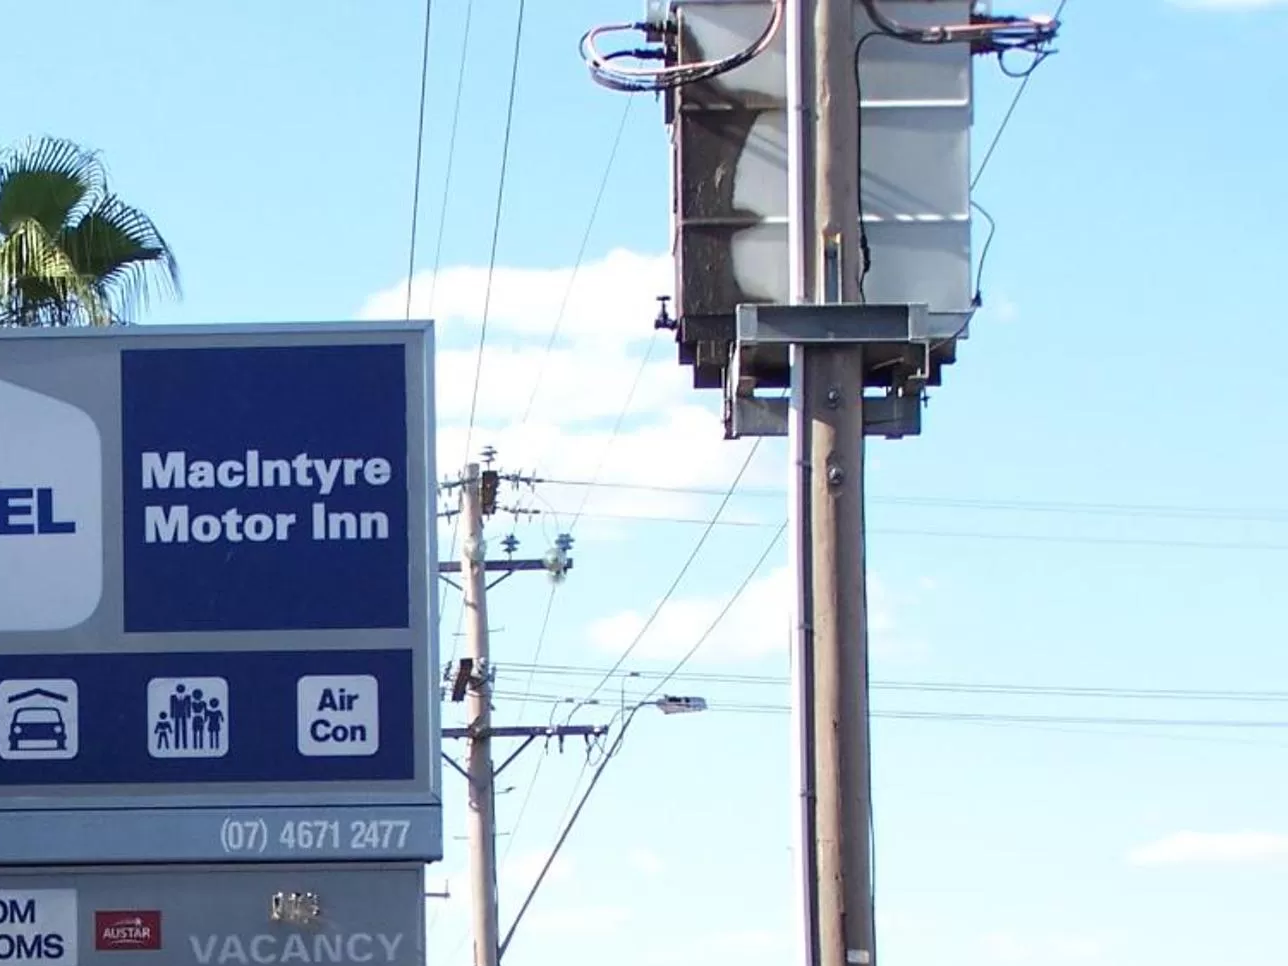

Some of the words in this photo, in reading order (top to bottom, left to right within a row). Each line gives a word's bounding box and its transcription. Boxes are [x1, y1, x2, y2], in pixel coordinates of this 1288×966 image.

[142, 450, 392, 495] MacIntyre
[145, 505, 296, 543] Motor
[312, 503, 390, 540] Inn
[317, 689, 359, 712] Air
[310, 719, 367, 743] Con
[220, 817, 269, 853] (07)
[279, 820, 341, 849] 4671
[350, 820, 412, 849] 2477
[103, 927, 152, 940] AUSTAR
[190, 932, 404, 965] VACANCY
